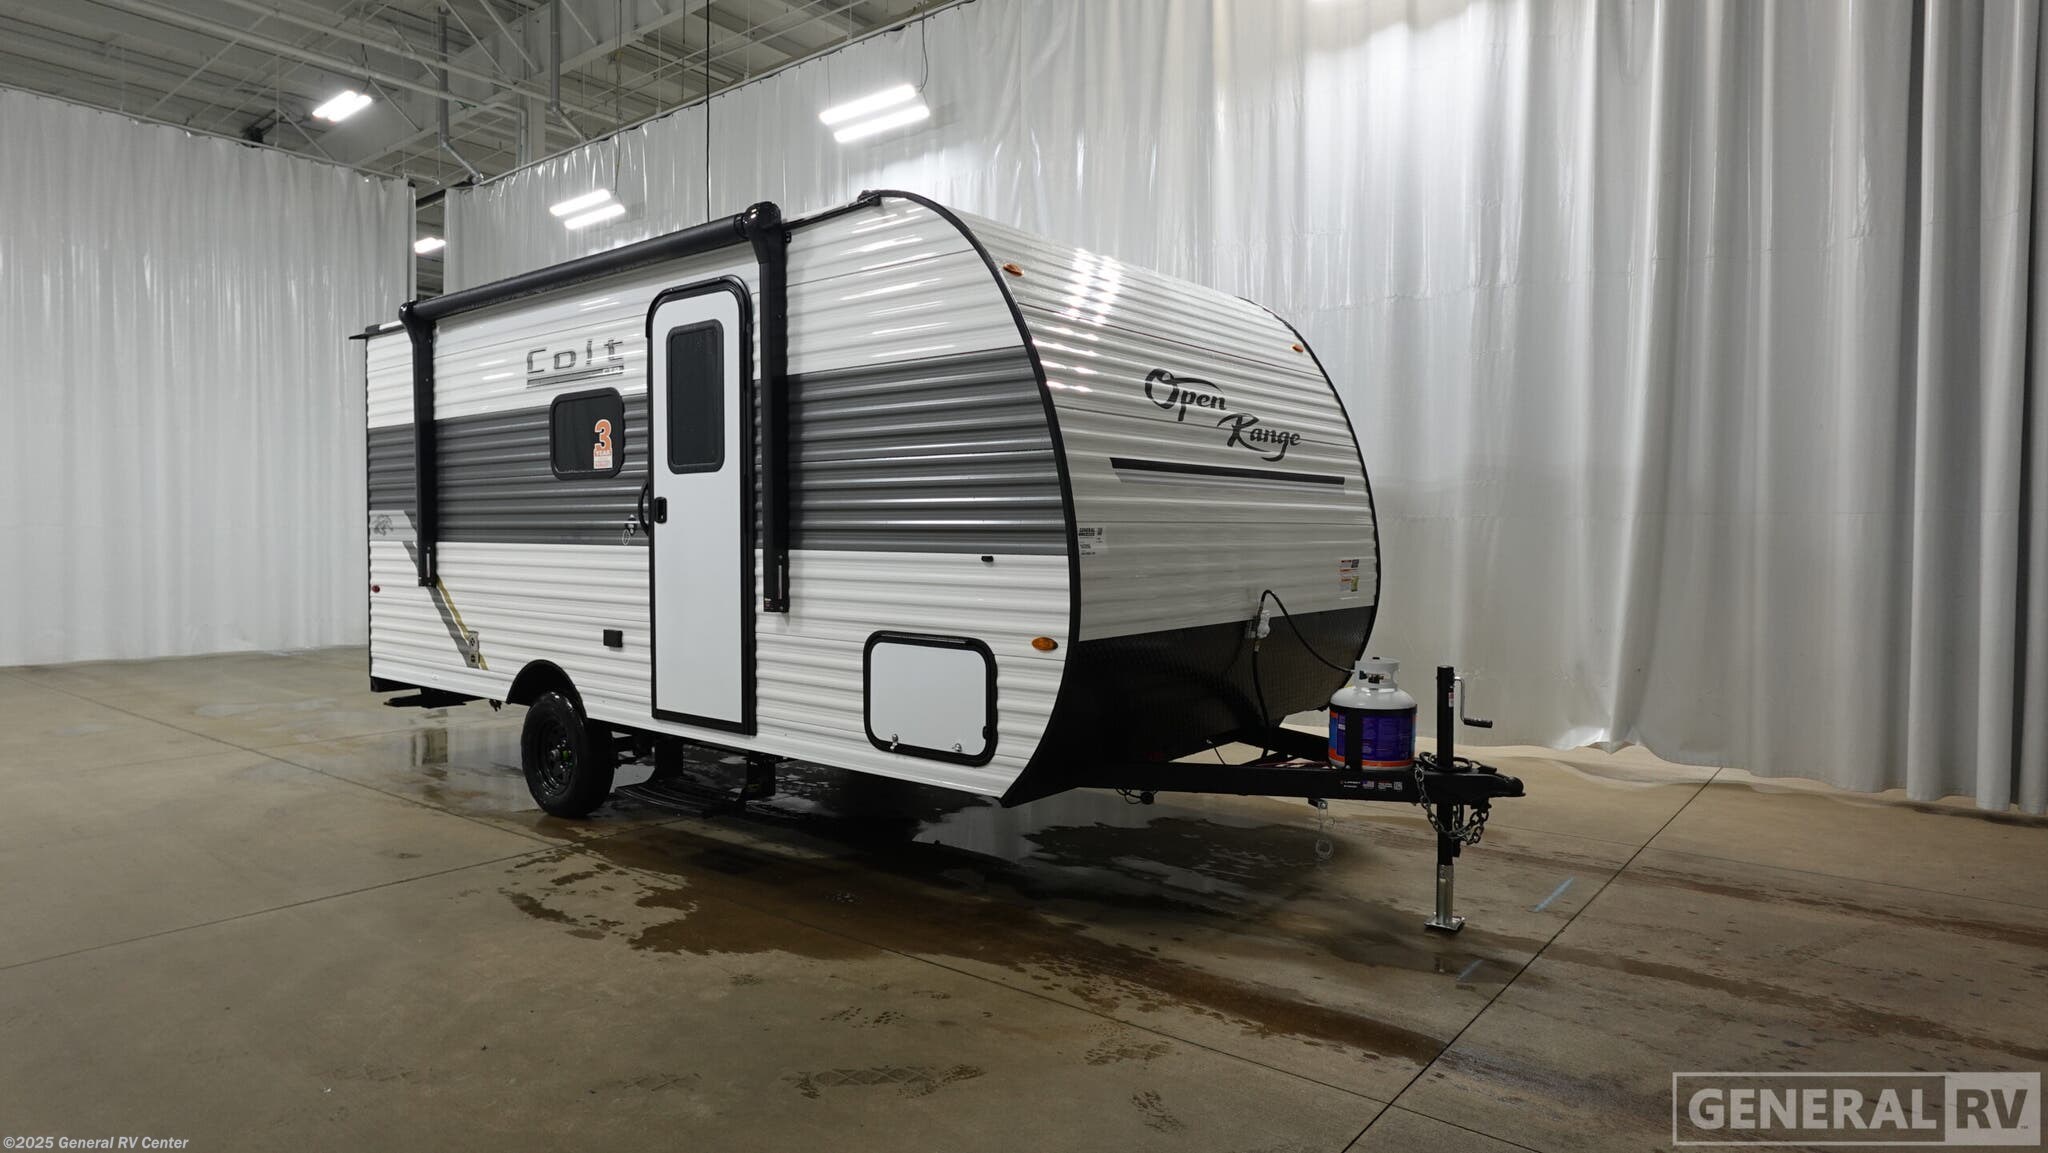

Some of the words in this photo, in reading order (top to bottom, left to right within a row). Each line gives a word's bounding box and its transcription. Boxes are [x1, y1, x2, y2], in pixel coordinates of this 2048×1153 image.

[527, 338, 623, 374] Colt
[1145, 368, 1227, 422] Open
[594, 419, 612, 450] 3
[1216, 412, 1301, 462] Range
